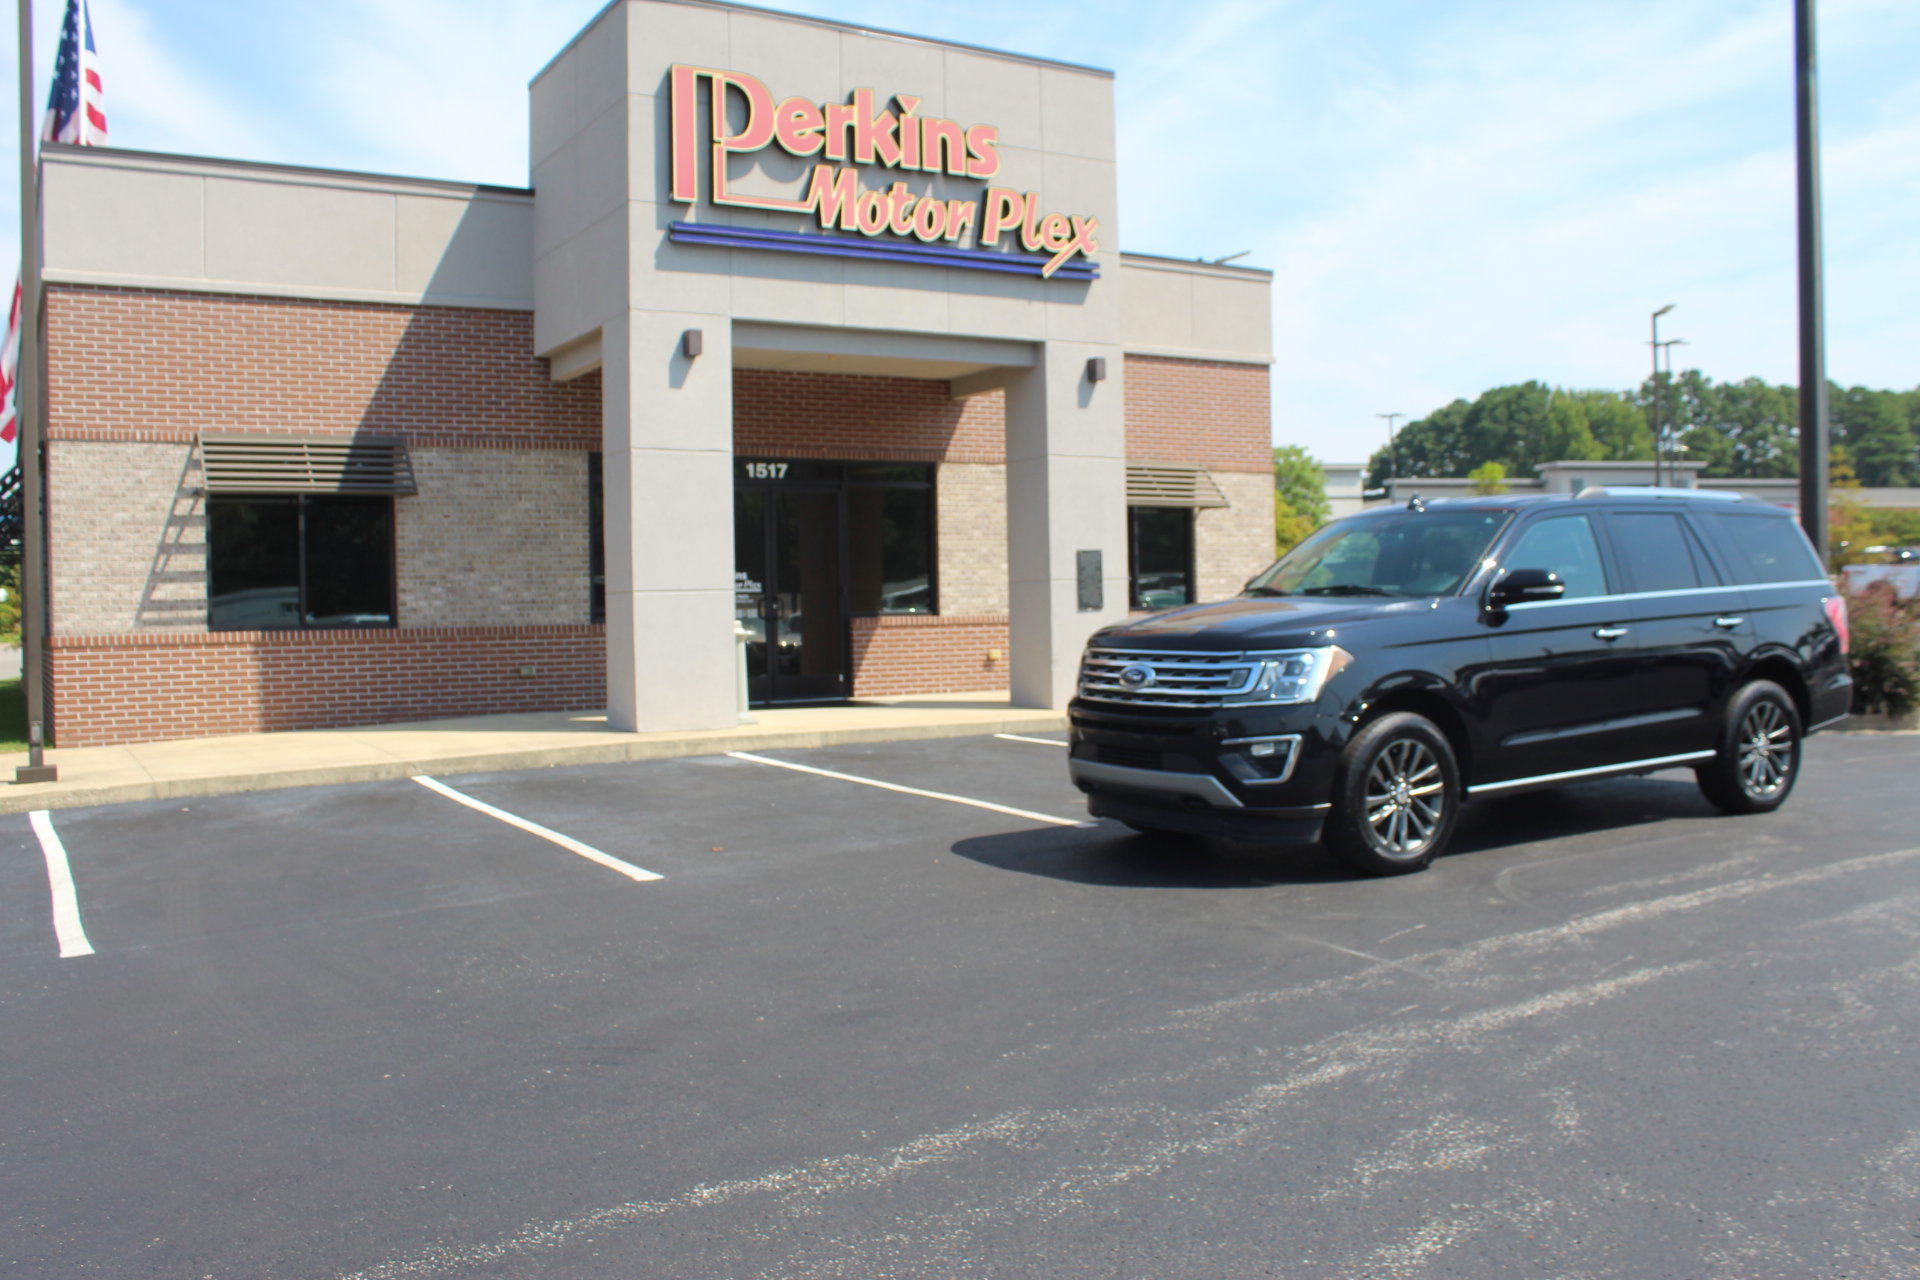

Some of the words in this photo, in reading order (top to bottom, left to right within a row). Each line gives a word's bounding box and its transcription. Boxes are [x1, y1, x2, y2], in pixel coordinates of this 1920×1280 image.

[671, 63, 1000, 203] Perkins
[812, 165, 976, 242] Motor
[981, 186, 1099, 278] Plex
[745, 462, 788, 479] 1517
